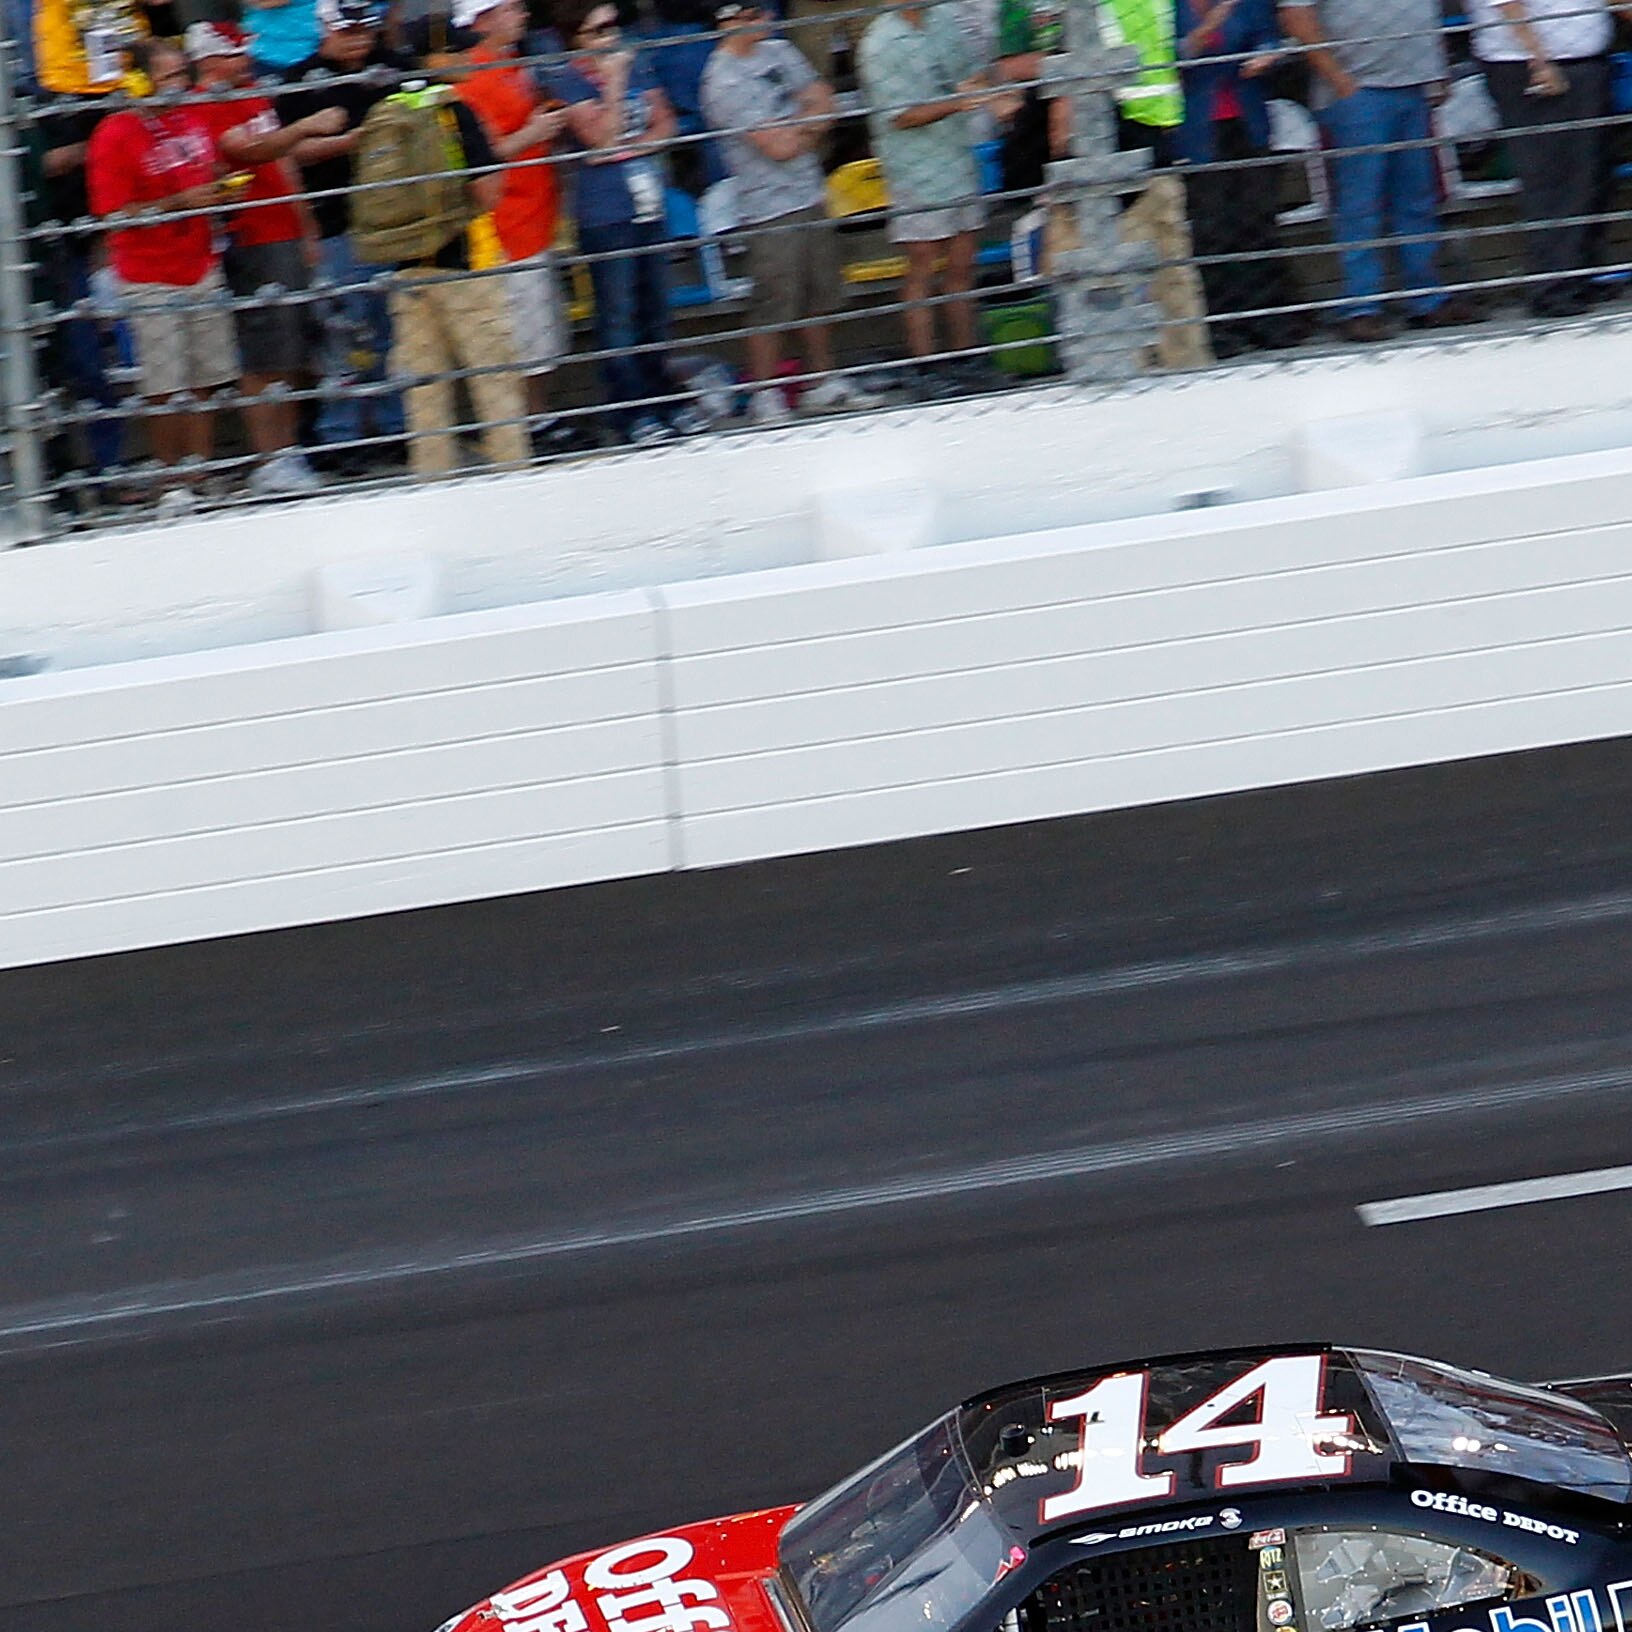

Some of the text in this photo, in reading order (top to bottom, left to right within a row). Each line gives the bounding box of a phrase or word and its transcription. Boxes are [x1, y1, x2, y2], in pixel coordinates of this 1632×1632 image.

[1040, 1354, 1353, 1522] 14
[1411, 1490, 1579, 1544] Office DEPOT
[1260, 1547, 1283, 1568] RITZ
